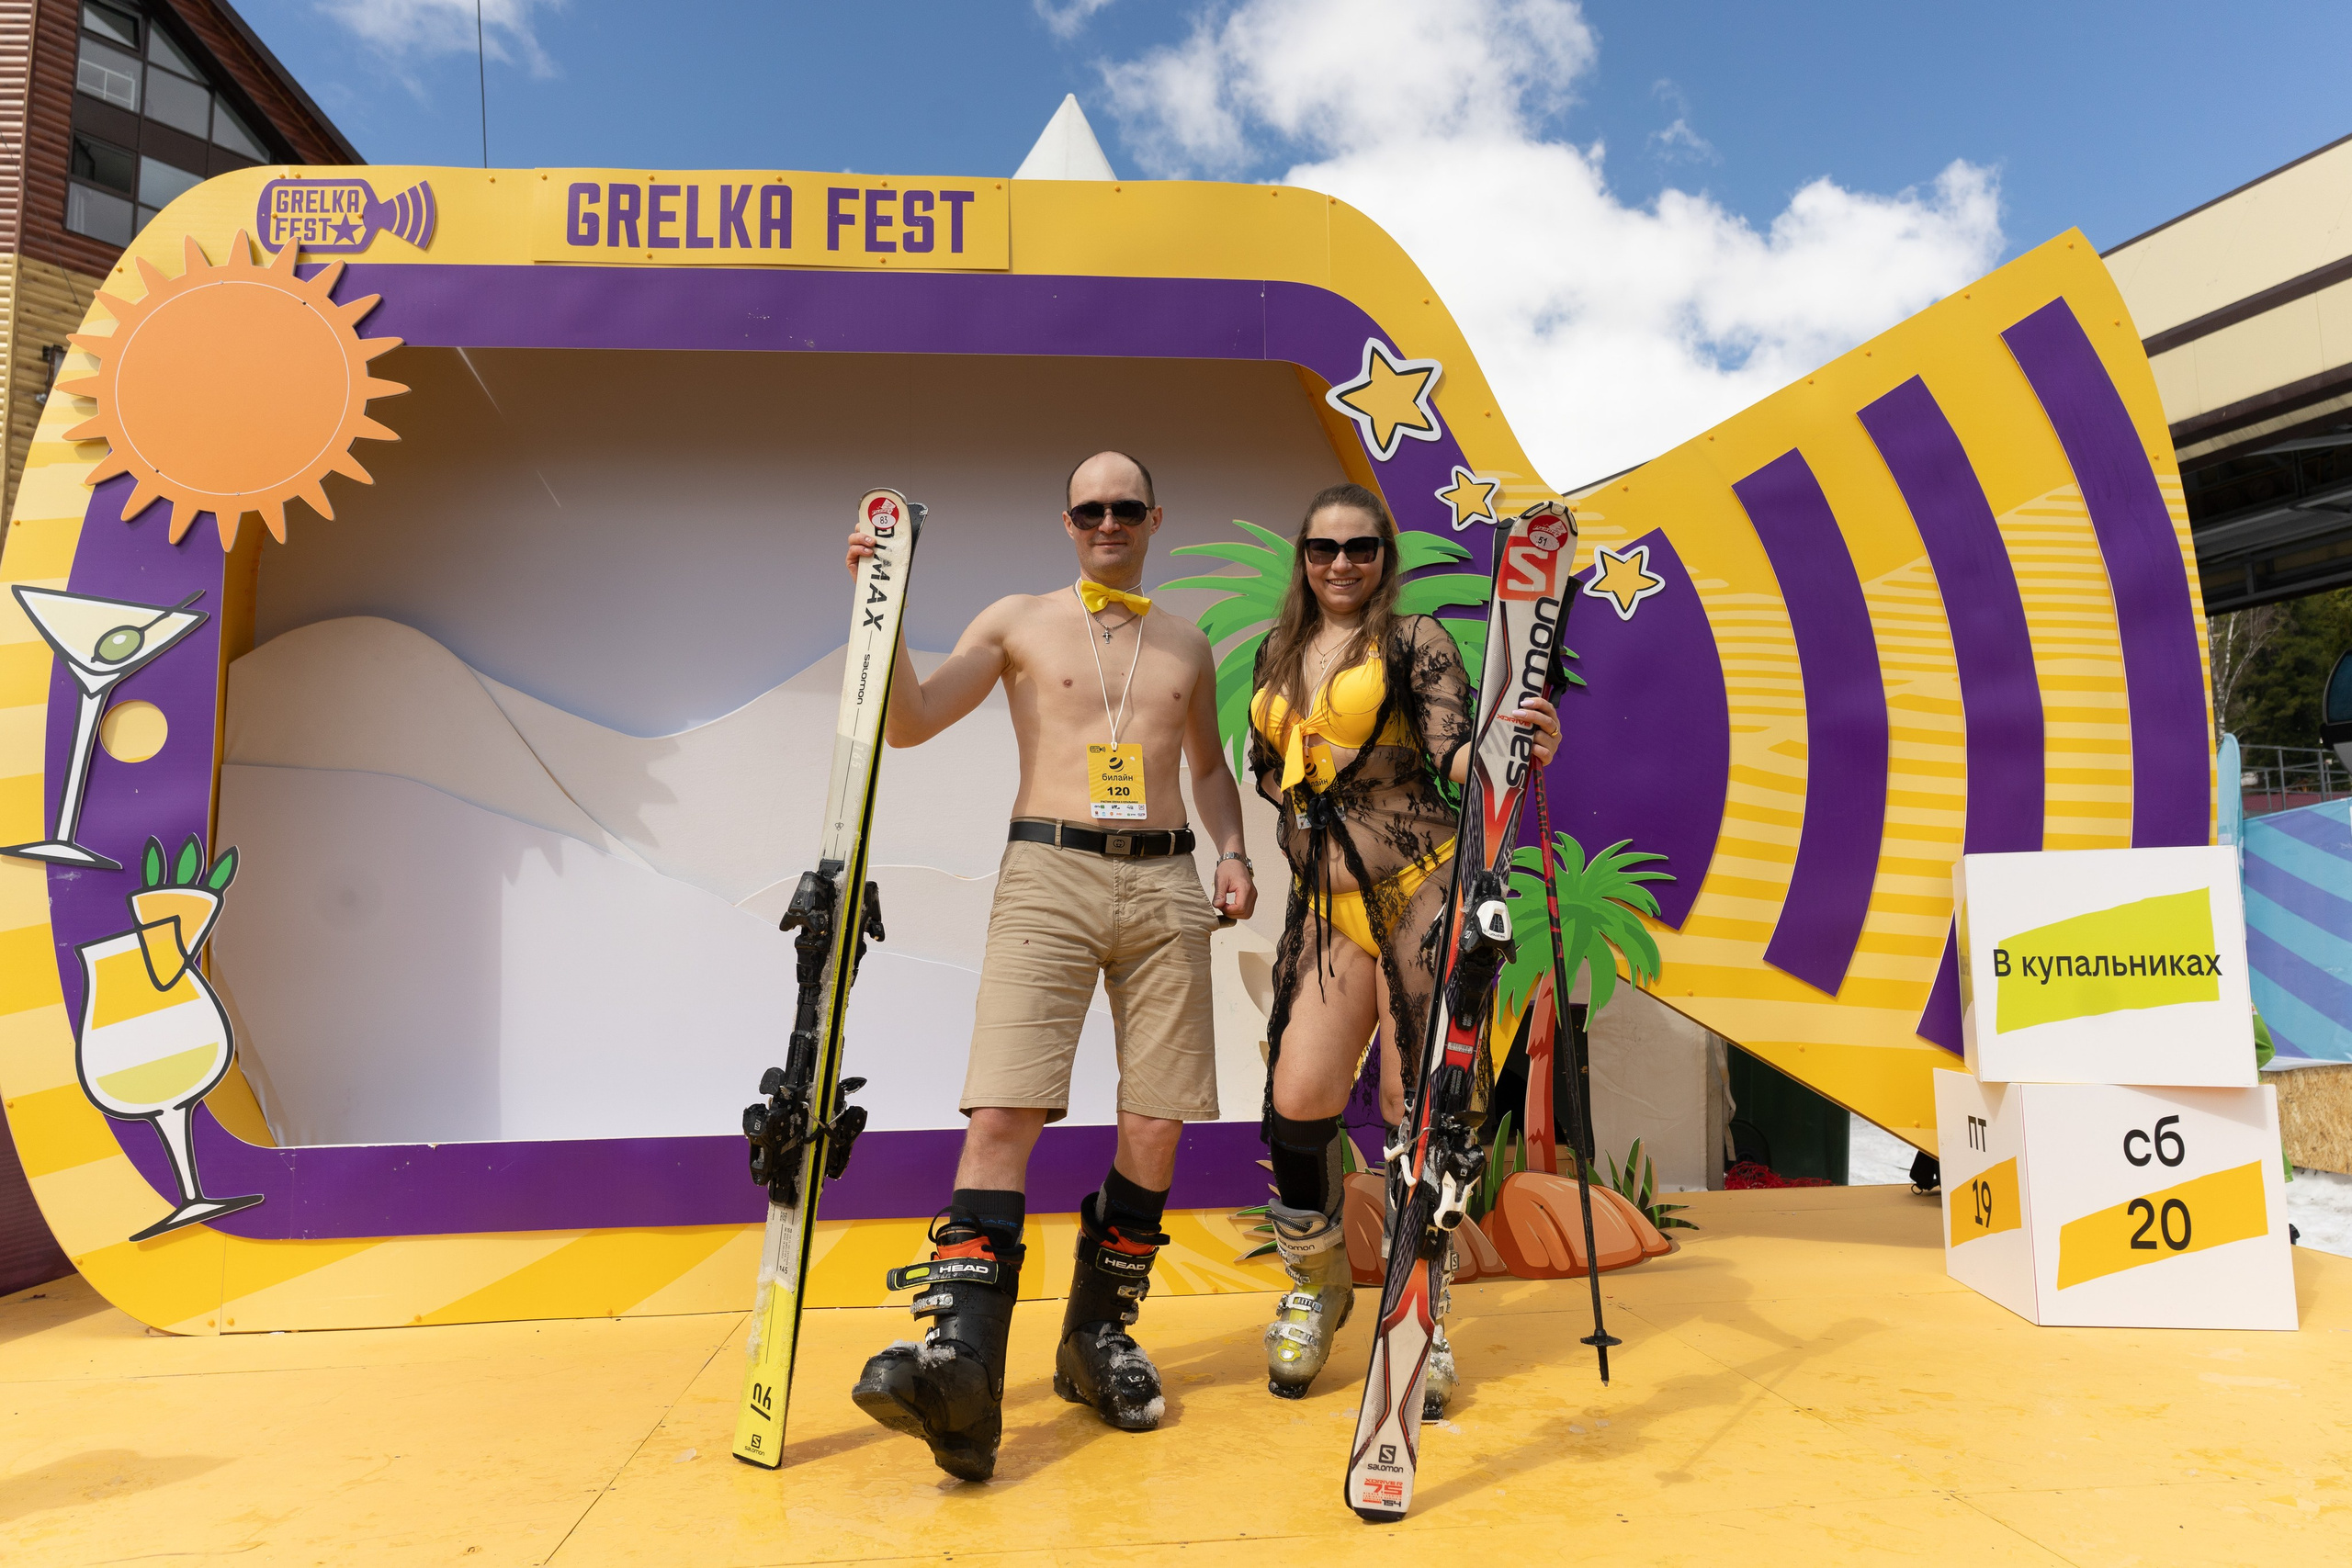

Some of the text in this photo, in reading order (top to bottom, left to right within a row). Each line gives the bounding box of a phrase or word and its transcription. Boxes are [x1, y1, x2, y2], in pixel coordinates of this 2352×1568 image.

[276, 189, 359, 214] GRELKA
[275, 218, 333, 242] FEST
[566, 182, 975, 254] GRELKA FEST
[879, 516, 888, 525] 83
[1538, 536, 1548, 547] 51
[856, 654, 871, 705] salomon
[1102, 773, 1134, 782] билайн
[1107, 786, 1130, 796] 120
[1532, 769, 1549, 840] ATOMIC
[1992, 949, 2012, 977] В
[2022, 950, 2222, 985] купальниках
[1967, 1114, 1987, 1153] пт
[2123, 1113, 2186, 1167] сб
[1972, 1178, 1993, 1229] 19
[2125, 1197, 2192, 1251] 20
[939, 1265, 989, 1274] HEAD
[1104, 1258, 1146, 1270] HEAD
[744, 1445, 765, 1456] salomon
[1367, 1463, 1403, 1472] salomon
[1382, 1498, 1402, 1507] 154
